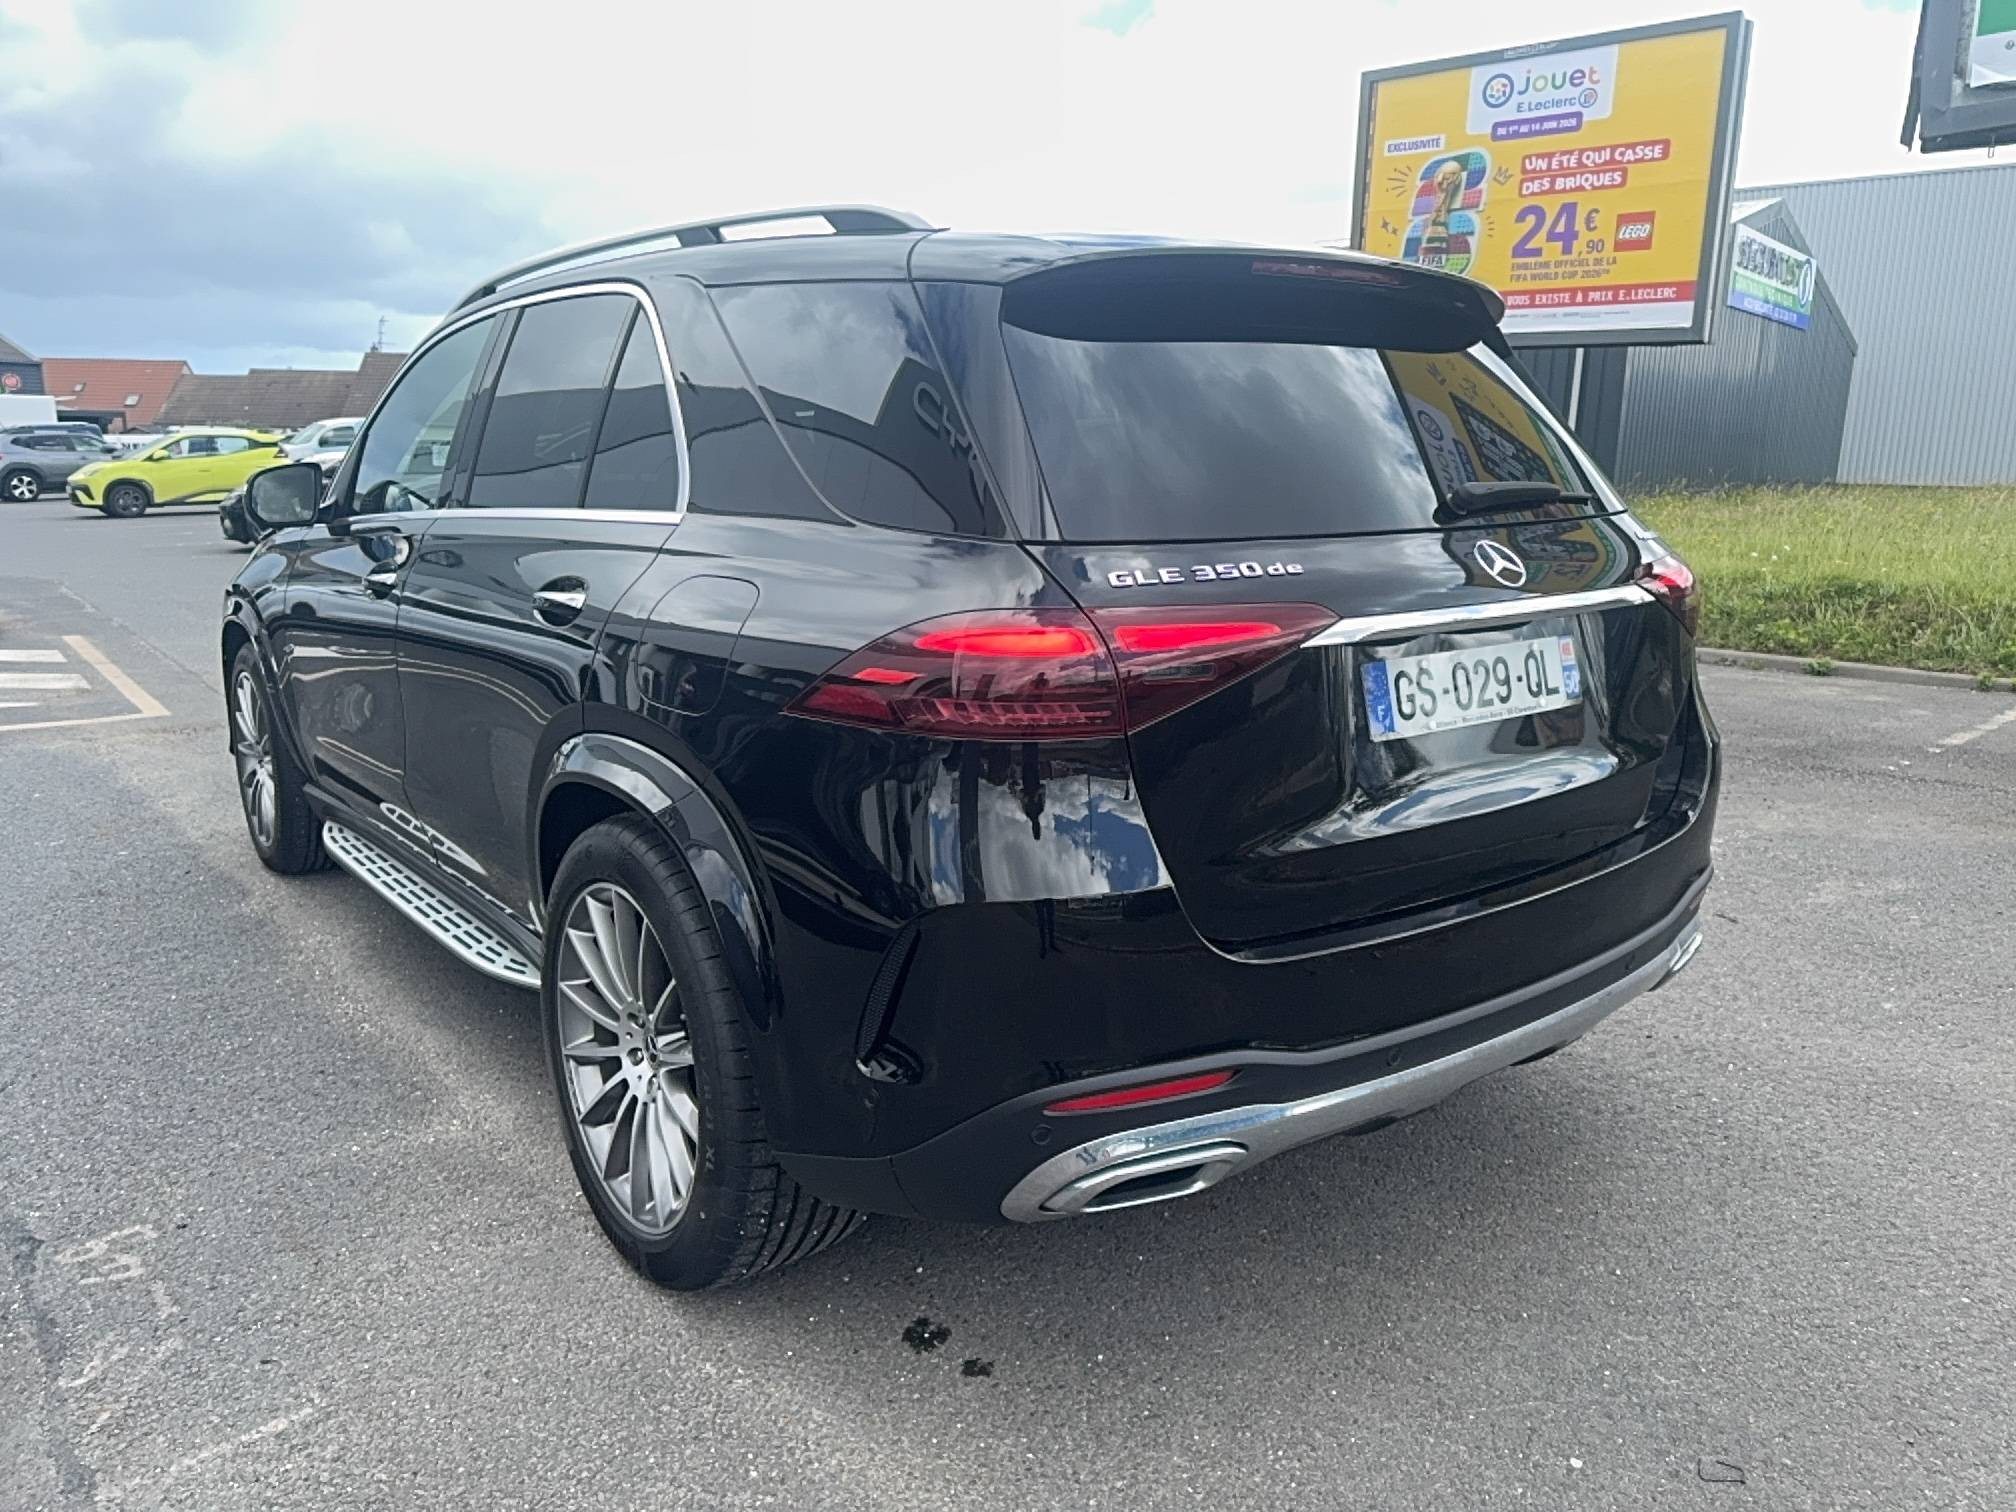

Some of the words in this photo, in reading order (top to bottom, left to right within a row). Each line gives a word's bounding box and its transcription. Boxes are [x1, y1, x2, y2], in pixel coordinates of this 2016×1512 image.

[1517, 66, 1601, 95] jouet
[1525, 156, 1547, 171] UN
[1551, 151, 1579, 170] ÉTÉ
[1582, 149, 1611, 167] QUI
[1614, 144, 1664, 163] CASSE
[1522, 177, 1551, 195] DES
[1554, 171, 1623, 190] BRIQUES
[1511, 201, 1580, 259] 24
[1618, 223, 1651, 240] LEGO
[1530, 270, 1559, 282] WORLD
[1535, 292, 1571, 305] EXISTE
[1588, 291, 1613, 302] PRIX
[1618, 287, 1677, 301] E.LECLERC
[1107, 566, 1185, 588] GLE
[1394, 650, 1560, 720] GS-029-QL
